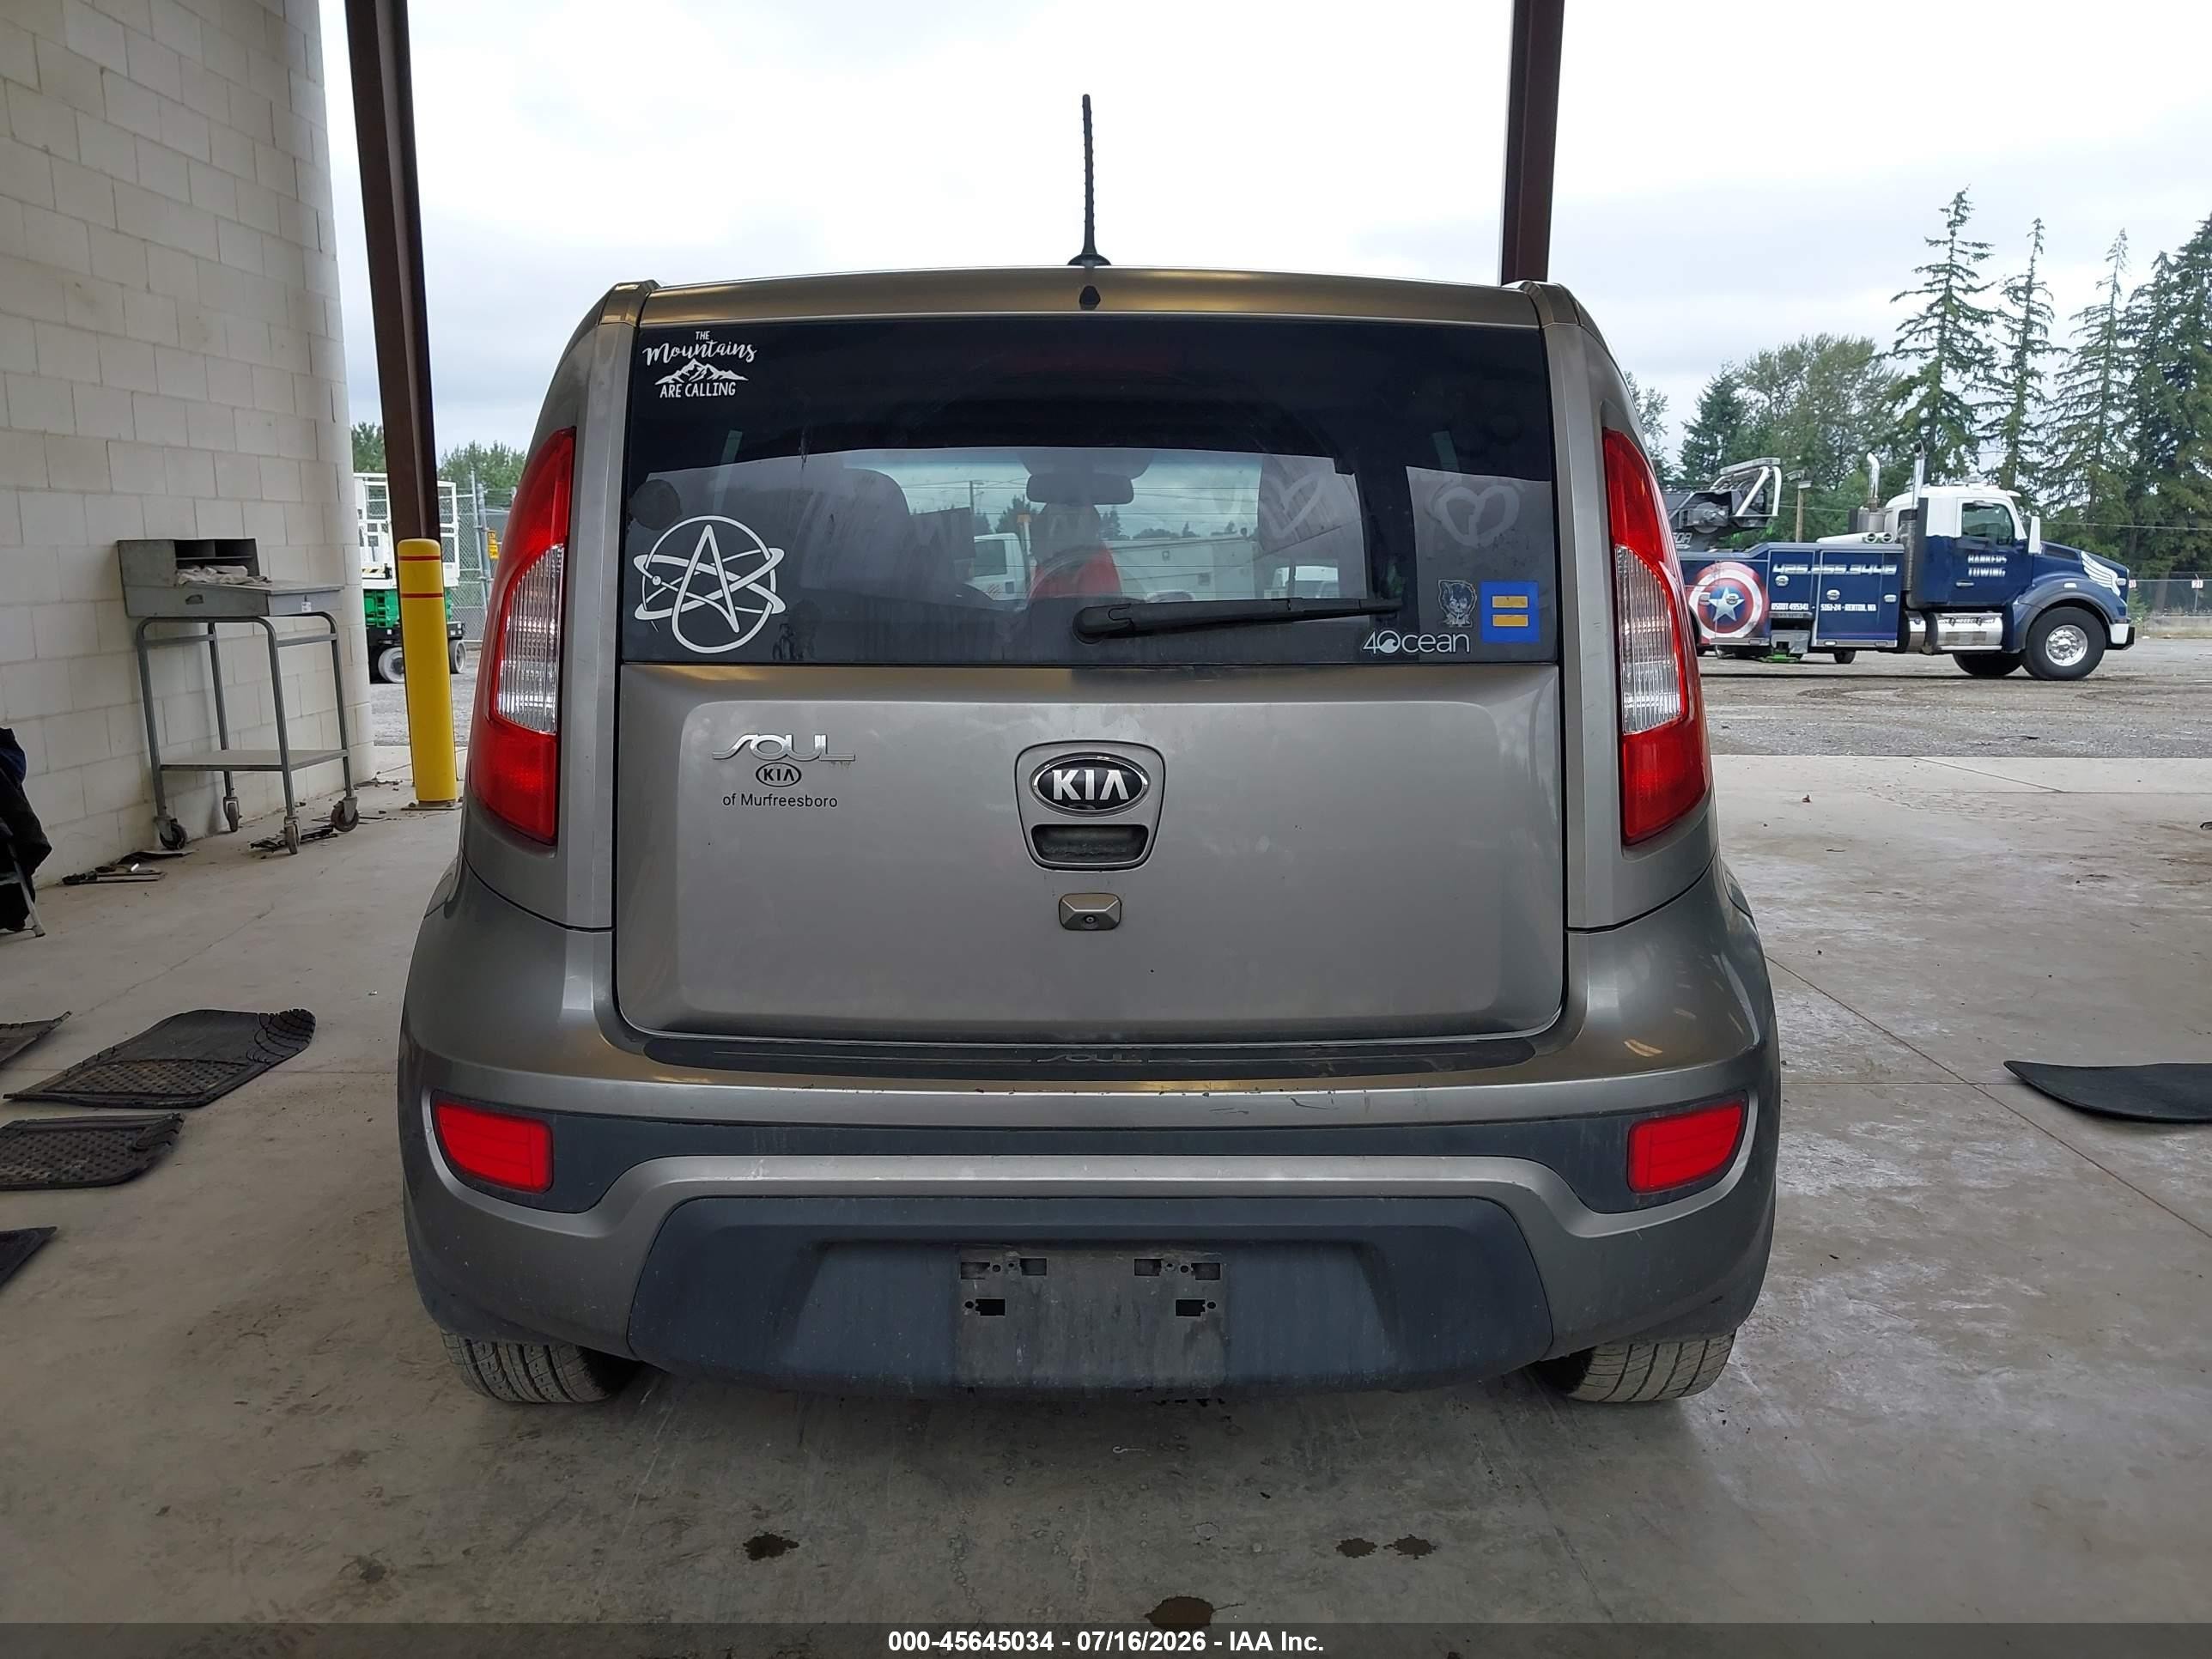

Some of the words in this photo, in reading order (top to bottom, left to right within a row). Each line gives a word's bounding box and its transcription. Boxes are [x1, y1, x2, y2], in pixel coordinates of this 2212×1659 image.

[696, 331, 711, 340] THE
[642, 339, 757, 366] Mountains
[659, 384, 682, 398] ARE
[684, 381, 737, 398] CALLING
[1968, 567, 2006, 577] TOWING
[1363, 629, 1470, 654] 4Ocean
[712, 733, 856, 762] SOUL
[763, 768, 795, 781] KIA
[1052, 769, 1129, 801] KIA
[722, 793, 737, 806] of
[740, 793, 838, 808] Murfreesboro
